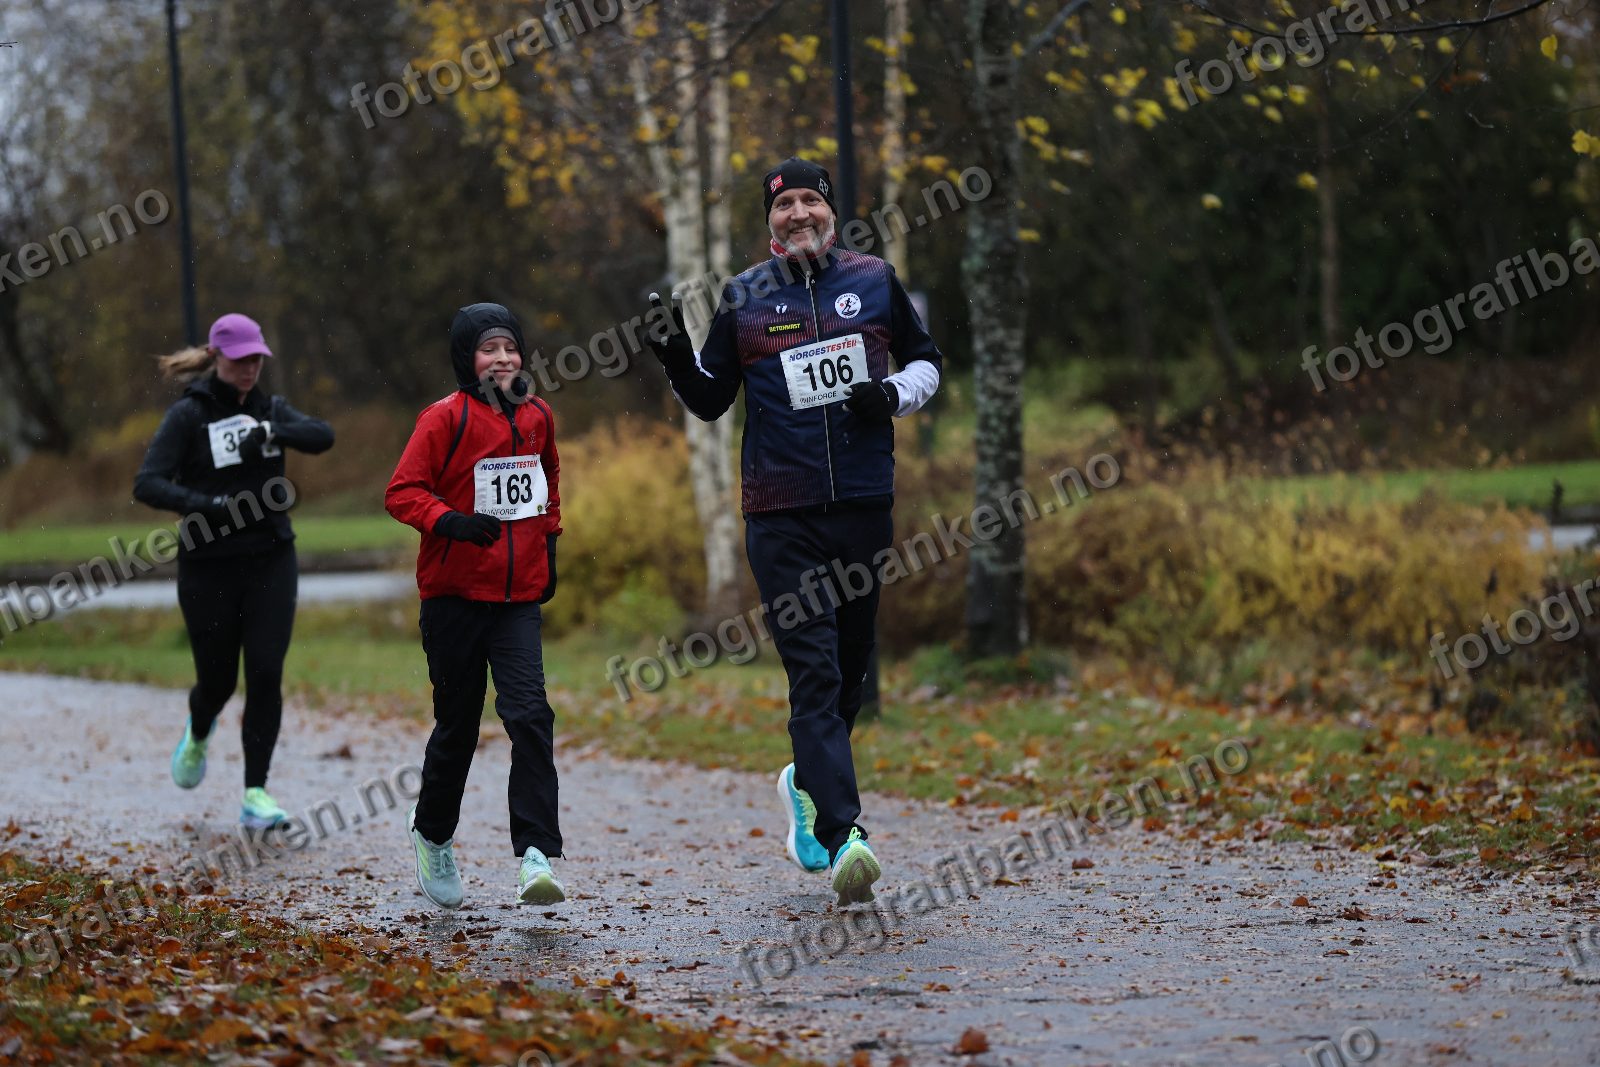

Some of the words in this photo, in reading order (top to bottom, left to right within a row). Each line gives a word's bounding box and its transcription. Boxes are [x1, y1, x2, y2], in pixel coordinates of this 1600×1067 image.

[789, 340, 857, 362] NORGESTESTEN
[802, 354, 854, 391] 106
[480, 460, 538, 471] NORGESTESTEN
[491, 473, 533, 505] 163
